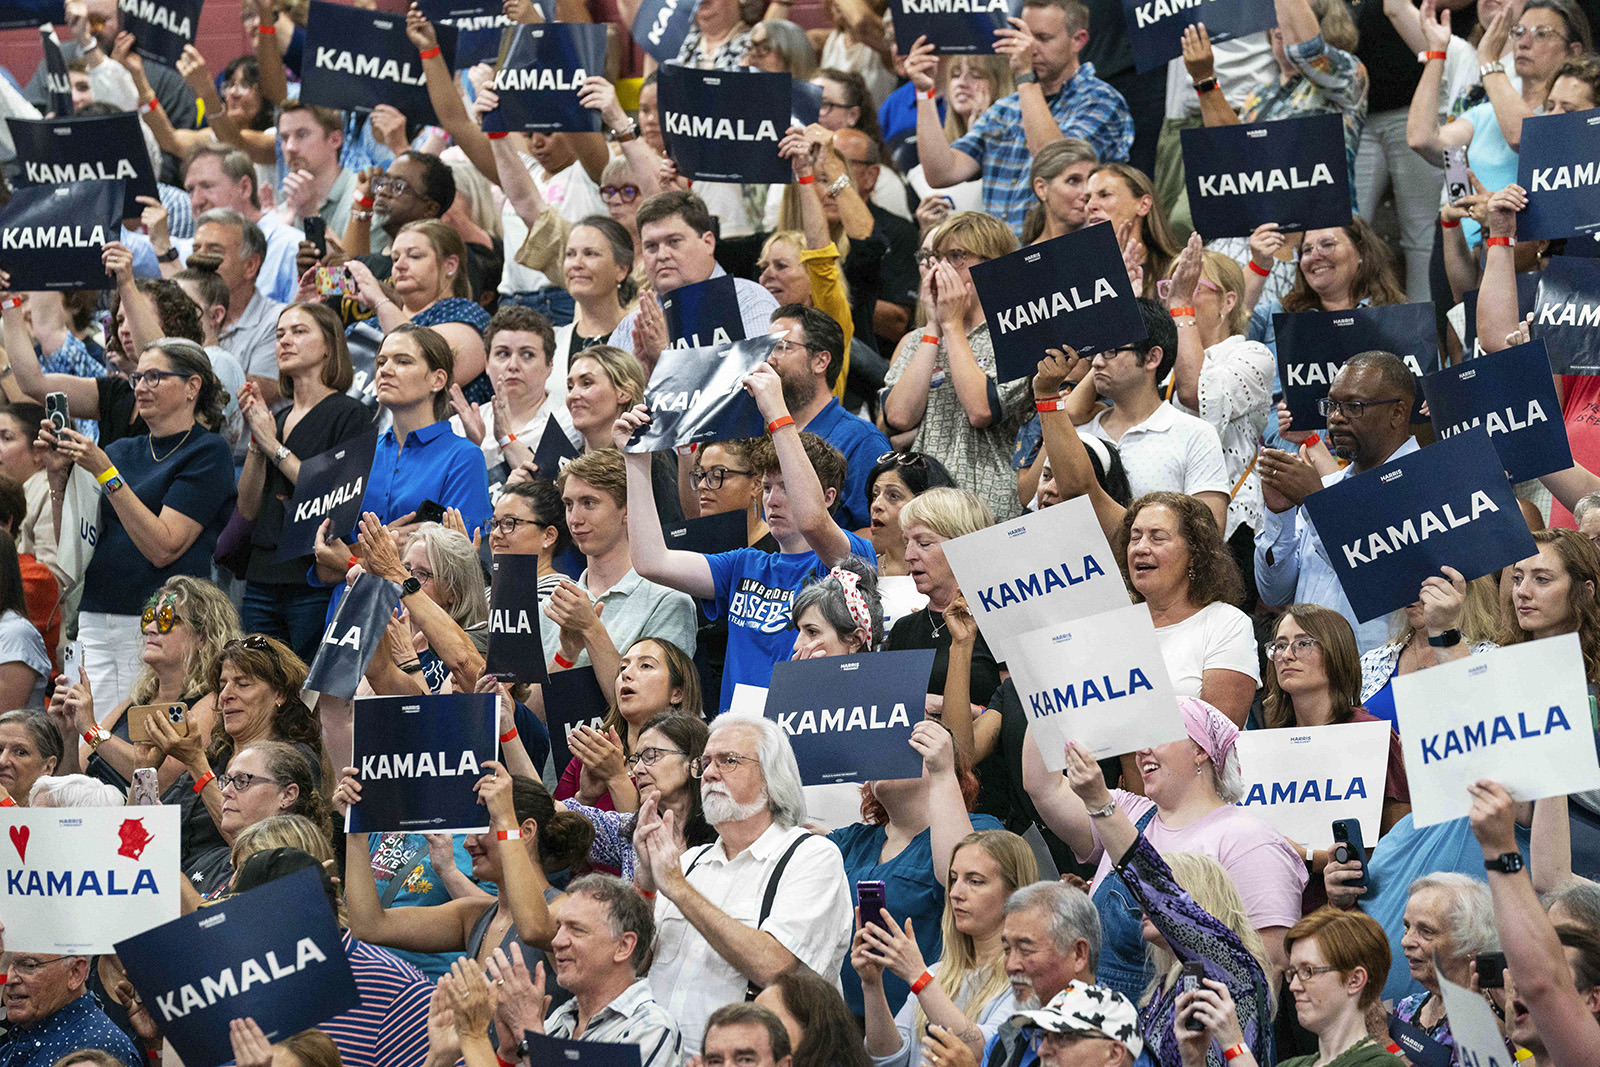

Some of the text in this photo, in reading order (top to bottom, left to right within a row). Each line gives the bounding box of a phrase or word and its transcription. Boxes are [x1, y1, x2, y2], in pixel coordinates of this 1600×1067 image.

[494, 68, 588, 91] KAMALA
[665, 111, 779, 142] KAMALA
[25, 158, 138, 184] KAMALA
[1198, 163, 1334, 197] KAMALA
[2, 224, 107, 250] KAMALA
[997, 277, 1119, 335] KAMALA
[1380, 468, 1402, 482] HARRIS
[295, 476, 363, 523] KAMALA
[1341, 489, 1500, 569] KAMALA
[977, 554, 1105, 613] KAMALA
[1028, 667, 1153, 719] KAMALA
[776, 703, 910, 735] KAMALA
[1421, 705, 1571, 765] KAMALA
[361, 750, 480, 780] KAMALA
[1236, 776, 1367, 806] AMALA
[6, 869, 160, 896] KAMALA
[157, 937, 326, 1022] KAMALA
[1401, 1033, 1424, 1051] HARRIS
